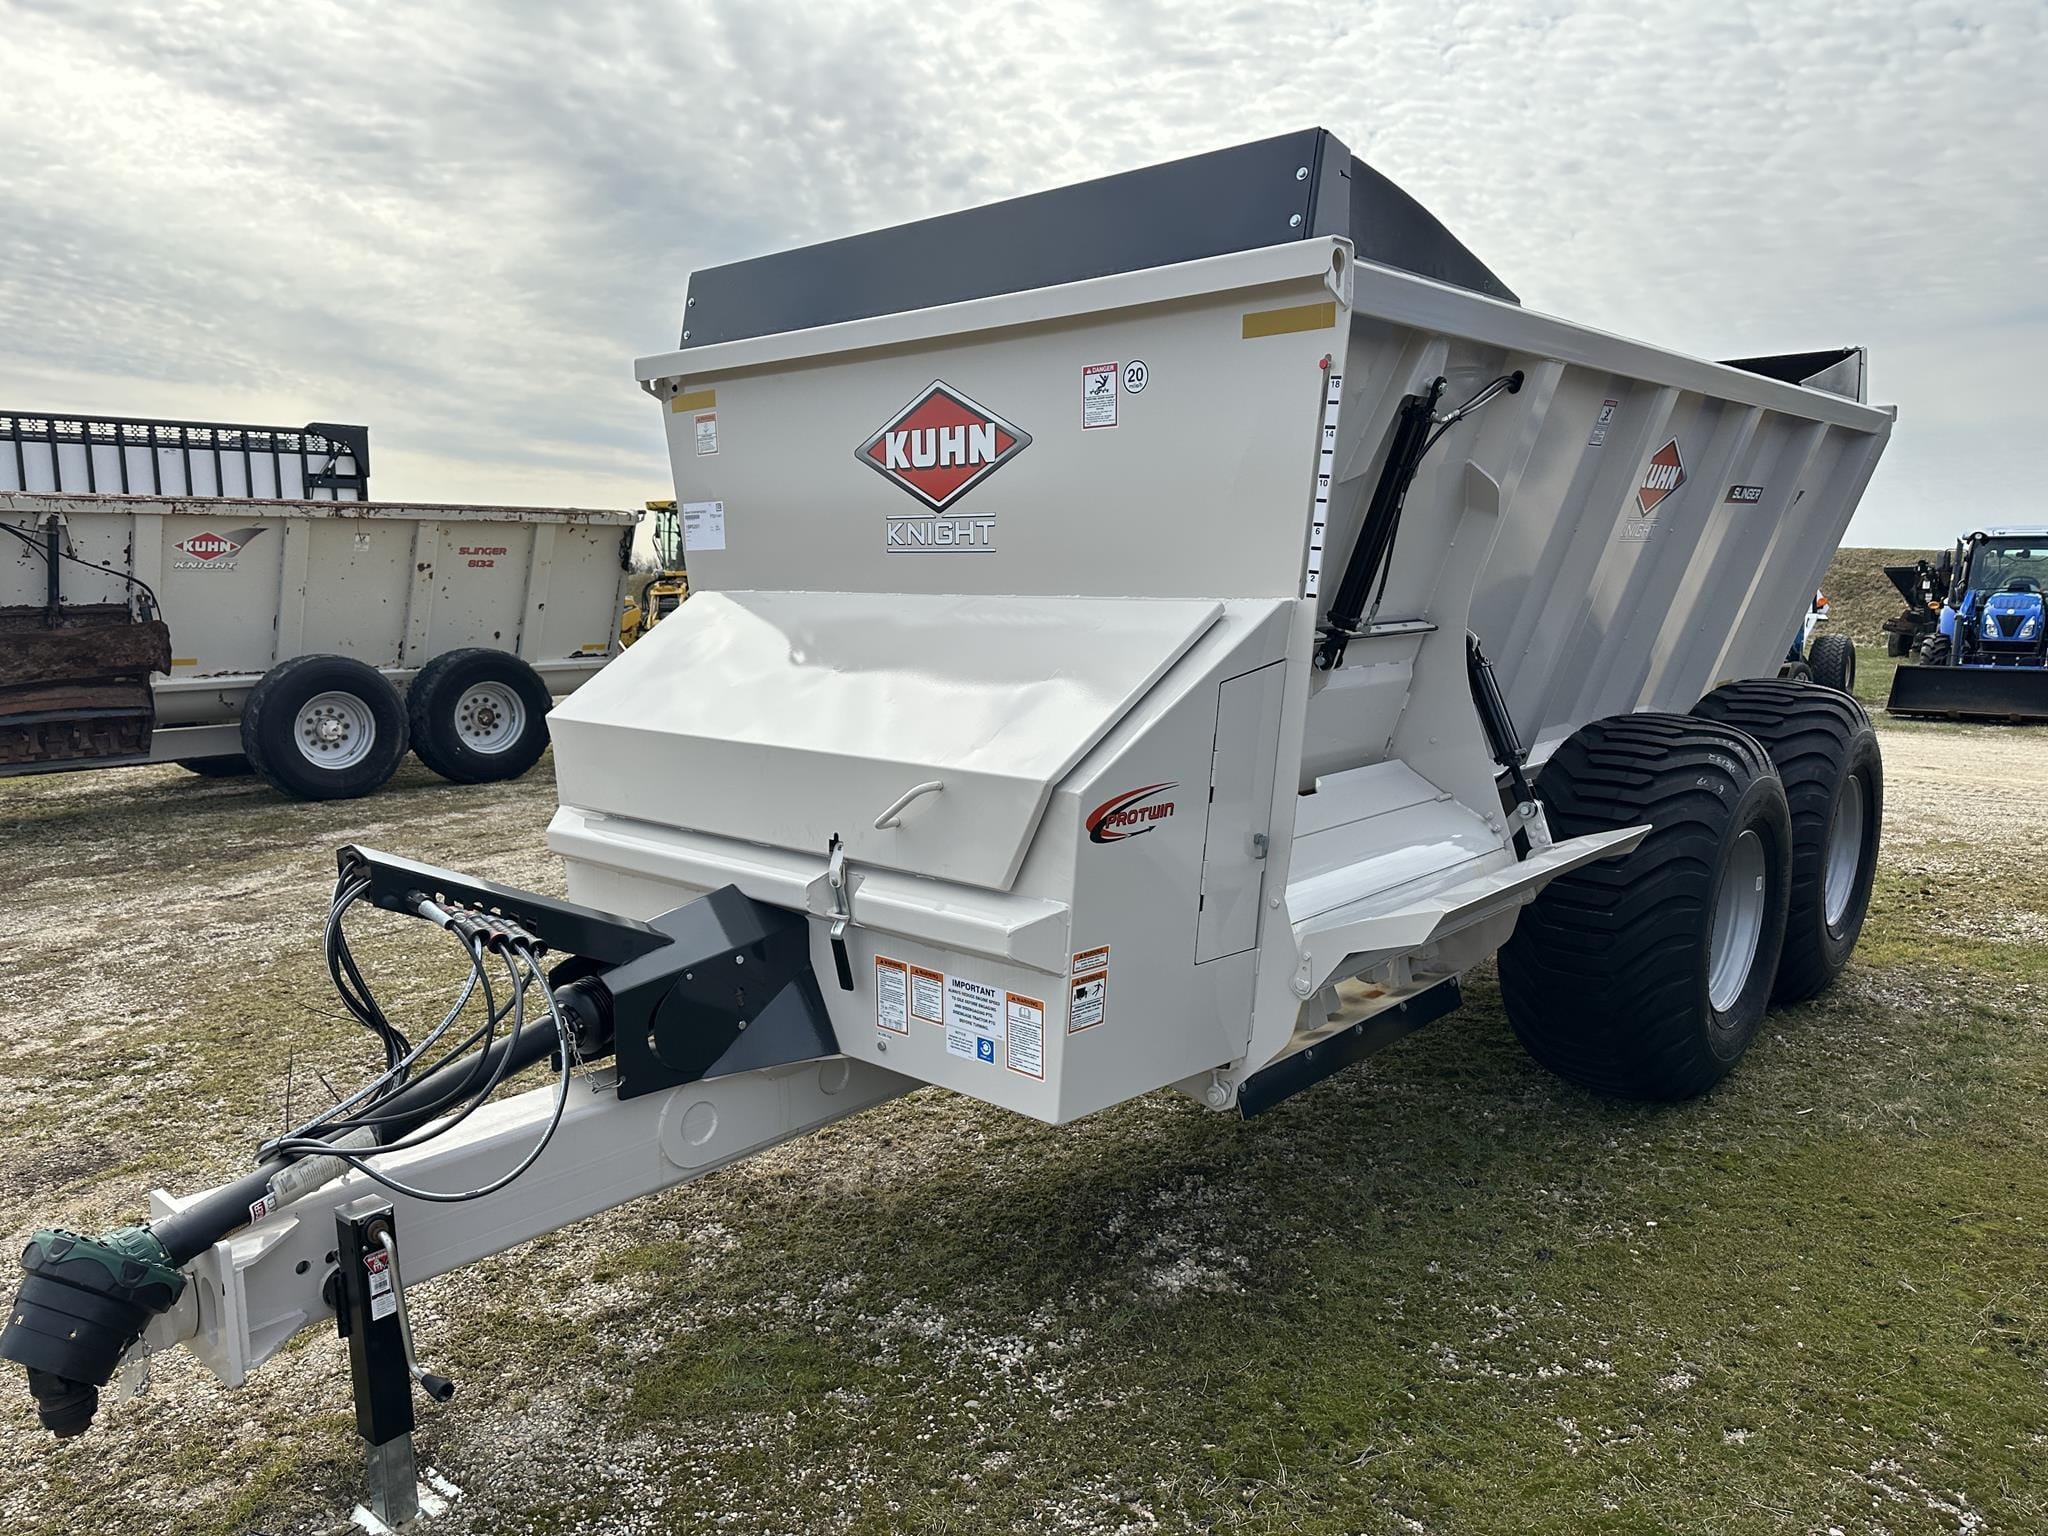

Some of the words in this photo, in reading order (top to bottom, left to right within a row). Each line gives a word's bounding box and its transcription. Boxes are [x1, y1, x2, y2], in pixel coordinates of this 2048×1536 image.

[1092, 365, 1114, 373] DANGER
[1128, 367, 1144, 382] 20
[1330, 380, 1340, 389] 18
[1324, 430, 1334, 438] 14
[885, 422, 996, 471] KUHN
[1318, 479, 1328, 487] 10
[1732, 487, 1761, 500] SLINGER
[886, 520, 995, 546] KNIGHT
[1315, 527, 1320, 535] 6
[182, 540, 232, 553] KUHN
[458, 546, 507, 556] SLINGER
[173, 560, 238, 571] KNIGHT
[467, 559, 495, 568] 8132
[1105, 802, 1175, 829] PROTWIN
[952, 979, 995, 997] IMPORTANT
